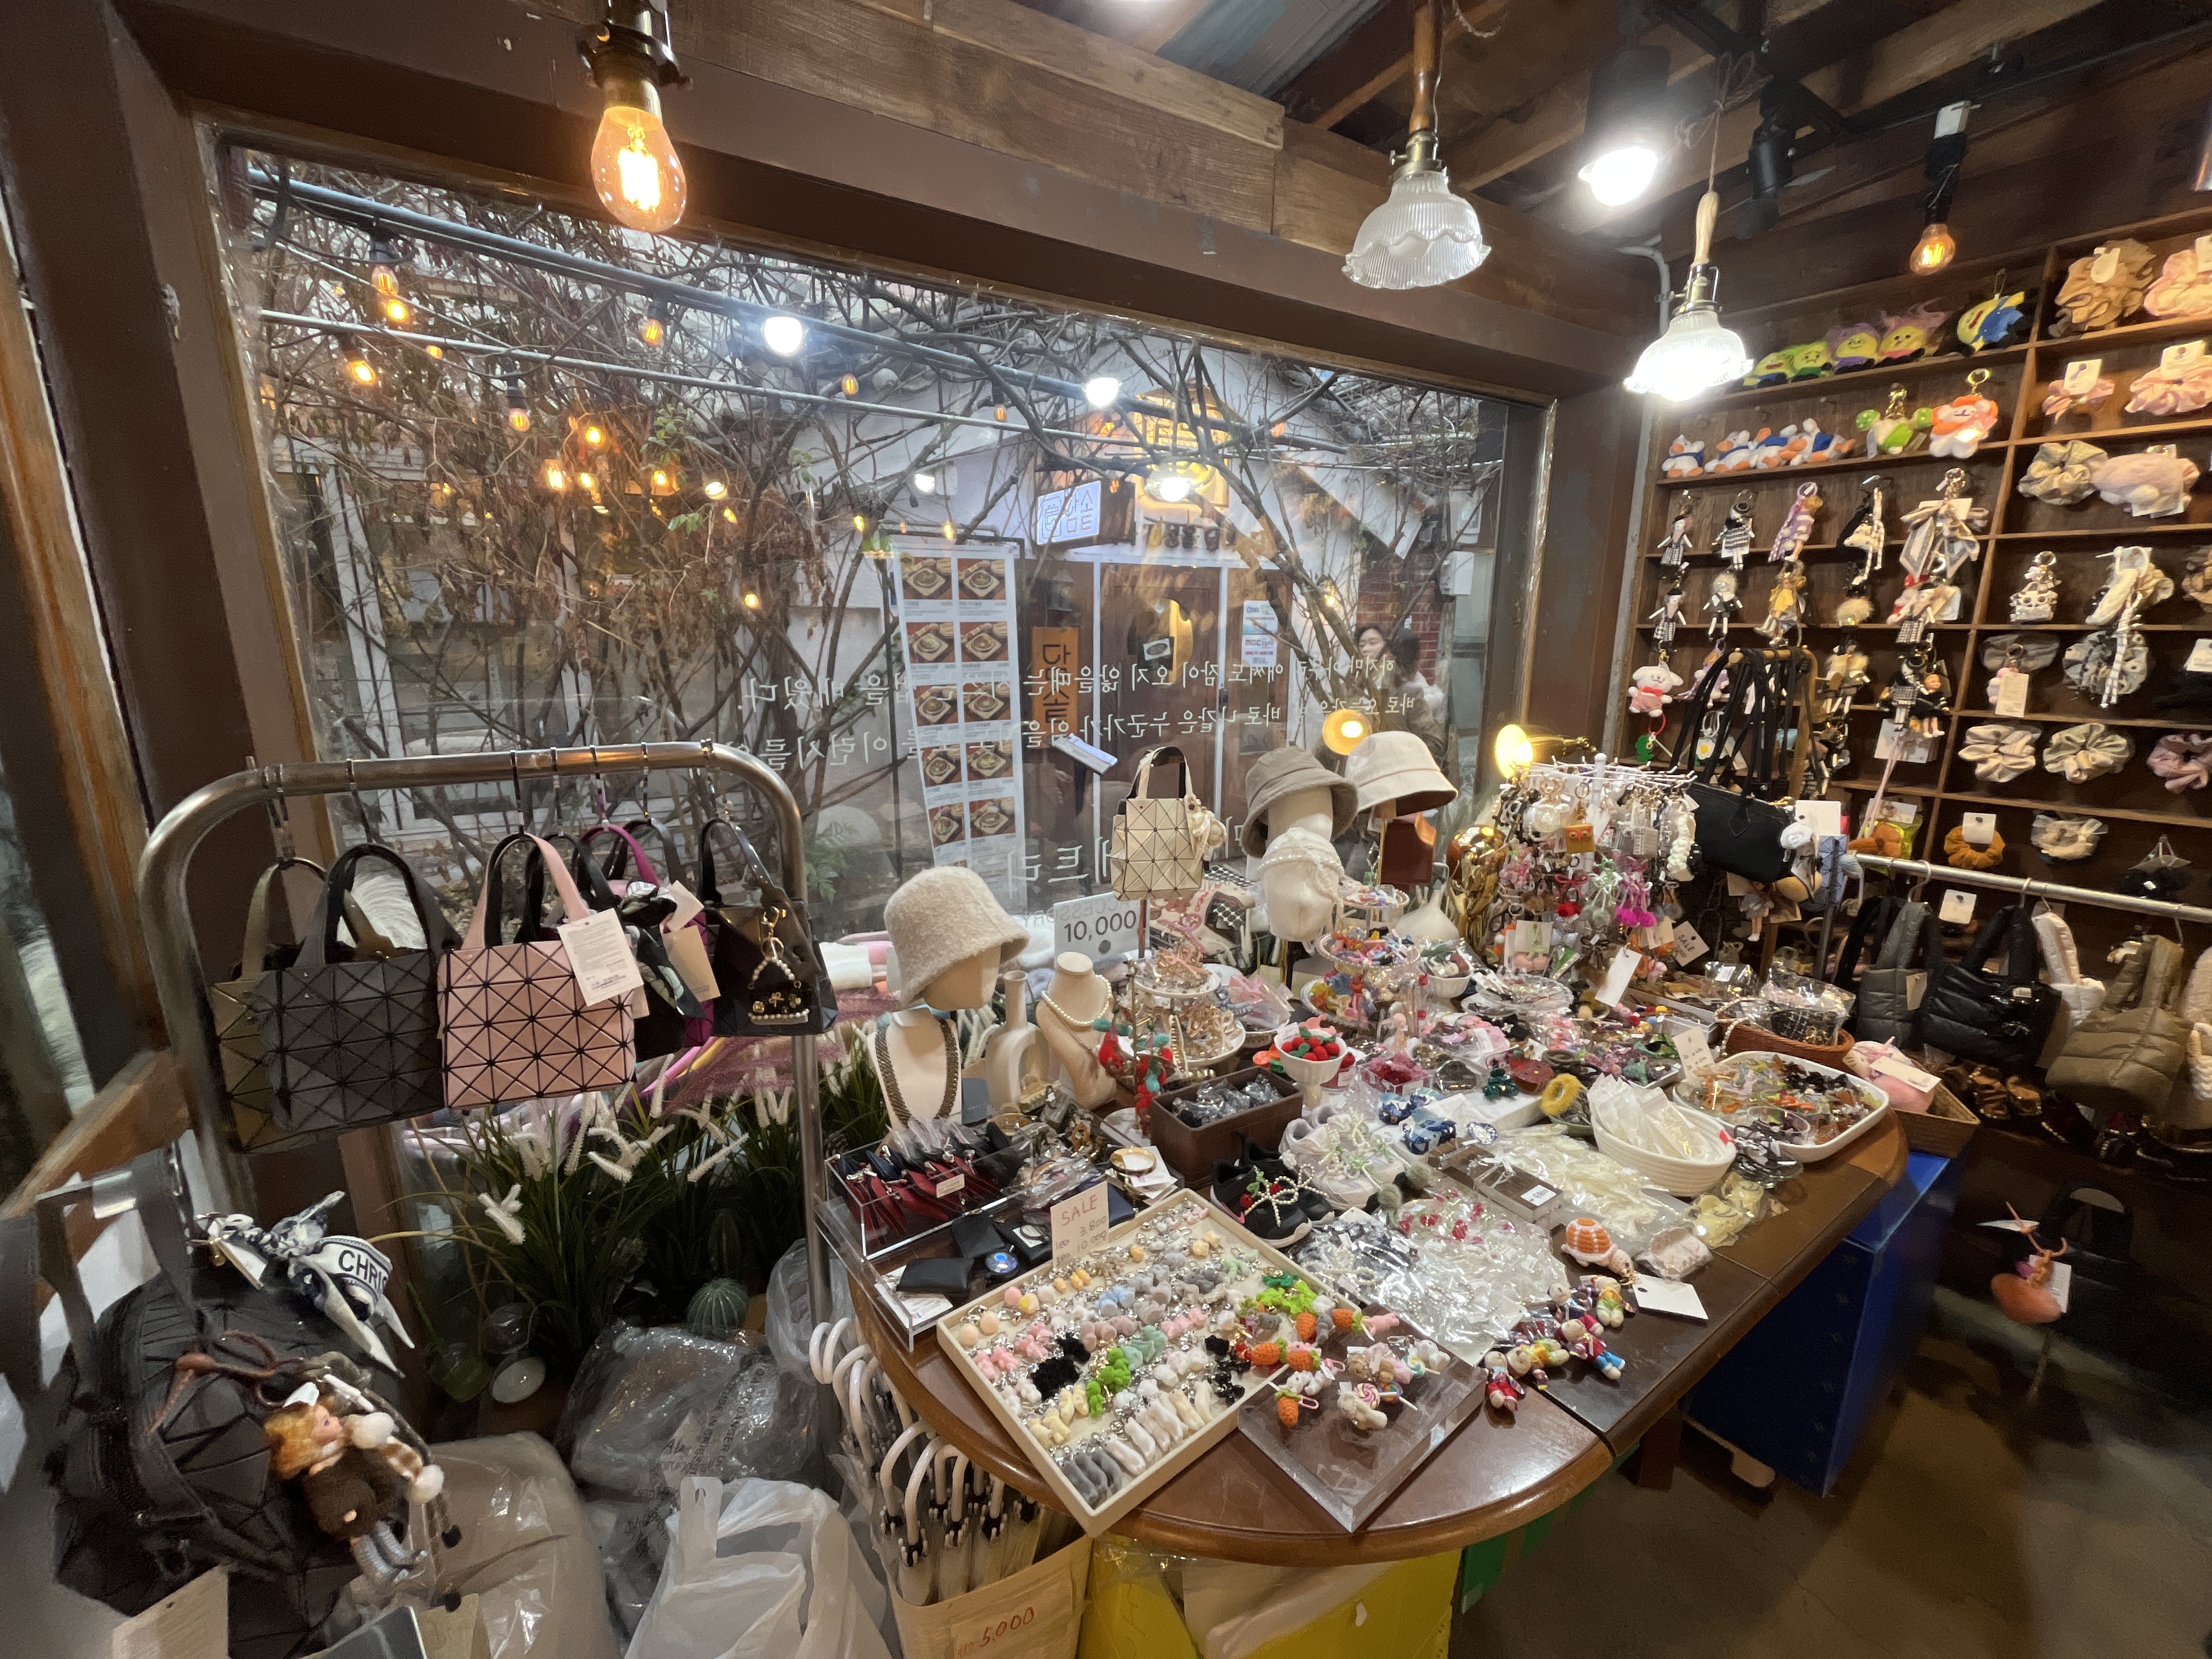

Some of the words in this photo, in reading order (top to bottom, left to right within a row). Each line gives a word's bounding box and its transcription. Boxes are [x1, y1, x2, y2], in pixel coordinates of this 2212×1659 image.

[1064, 910, 1137, 943] 10,000
[1678, 934, 1695, 952] SALE
[1062, 1194, 1098, 1226] SALE
